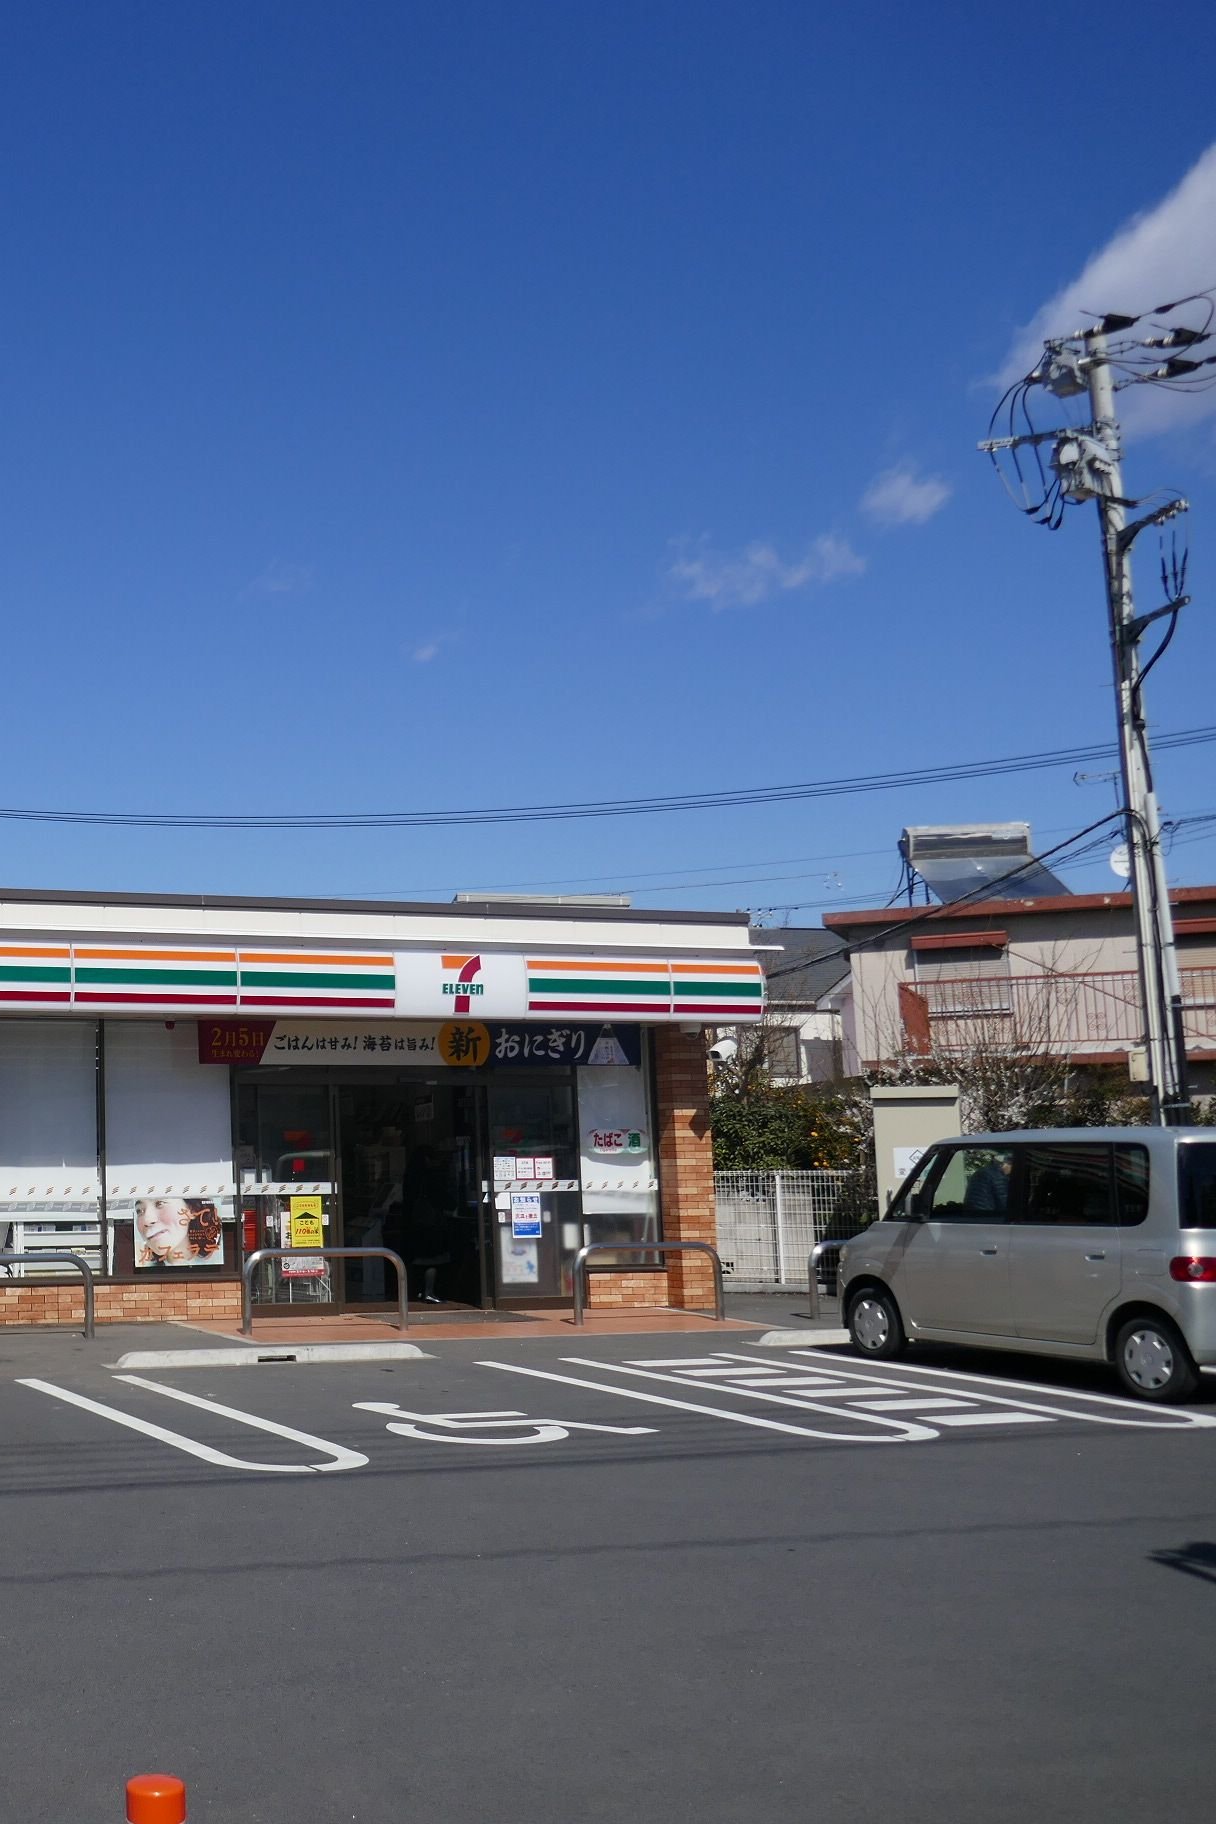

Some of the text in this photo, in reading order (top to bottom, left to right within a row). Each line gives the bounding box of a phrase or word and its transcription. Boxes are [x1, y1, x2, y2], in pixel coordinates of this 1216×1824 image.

[211, 1027, 265, 1047] 2月5日
[447, 1026, 482, 1062] 新
[495, 1028, 585, 1060] おにぎり
[593, 1132, 641, 1148] たばこ 酒
